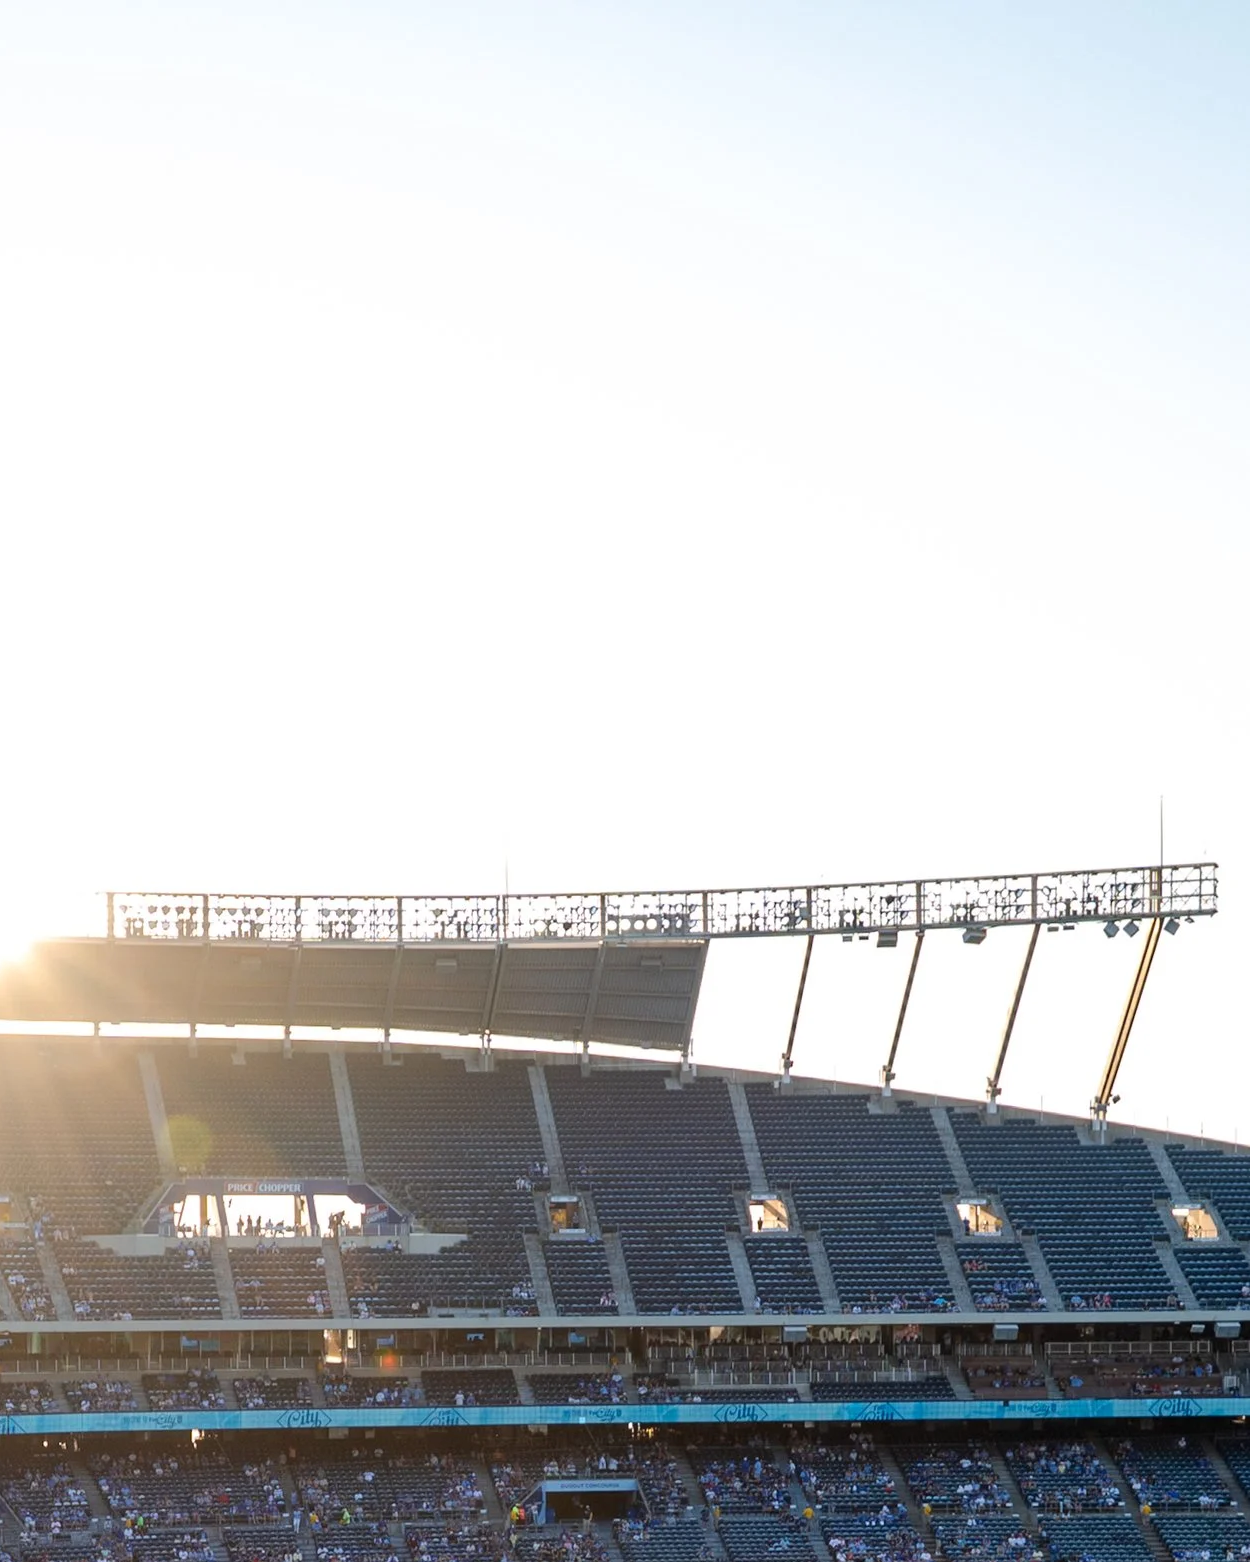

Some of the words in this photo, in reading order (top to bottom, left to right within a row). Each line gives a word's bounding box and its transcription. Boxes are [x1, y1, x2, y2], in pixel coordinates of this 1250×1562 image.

[228, 1183, 253, 1192] PRICE
[259, 1182, 301, 1193] CHOPPER
[724, 1404, 759, 1422] City
[1159, 1399, 1194, 1417] City
[287, 1409, 322, 1428] City
